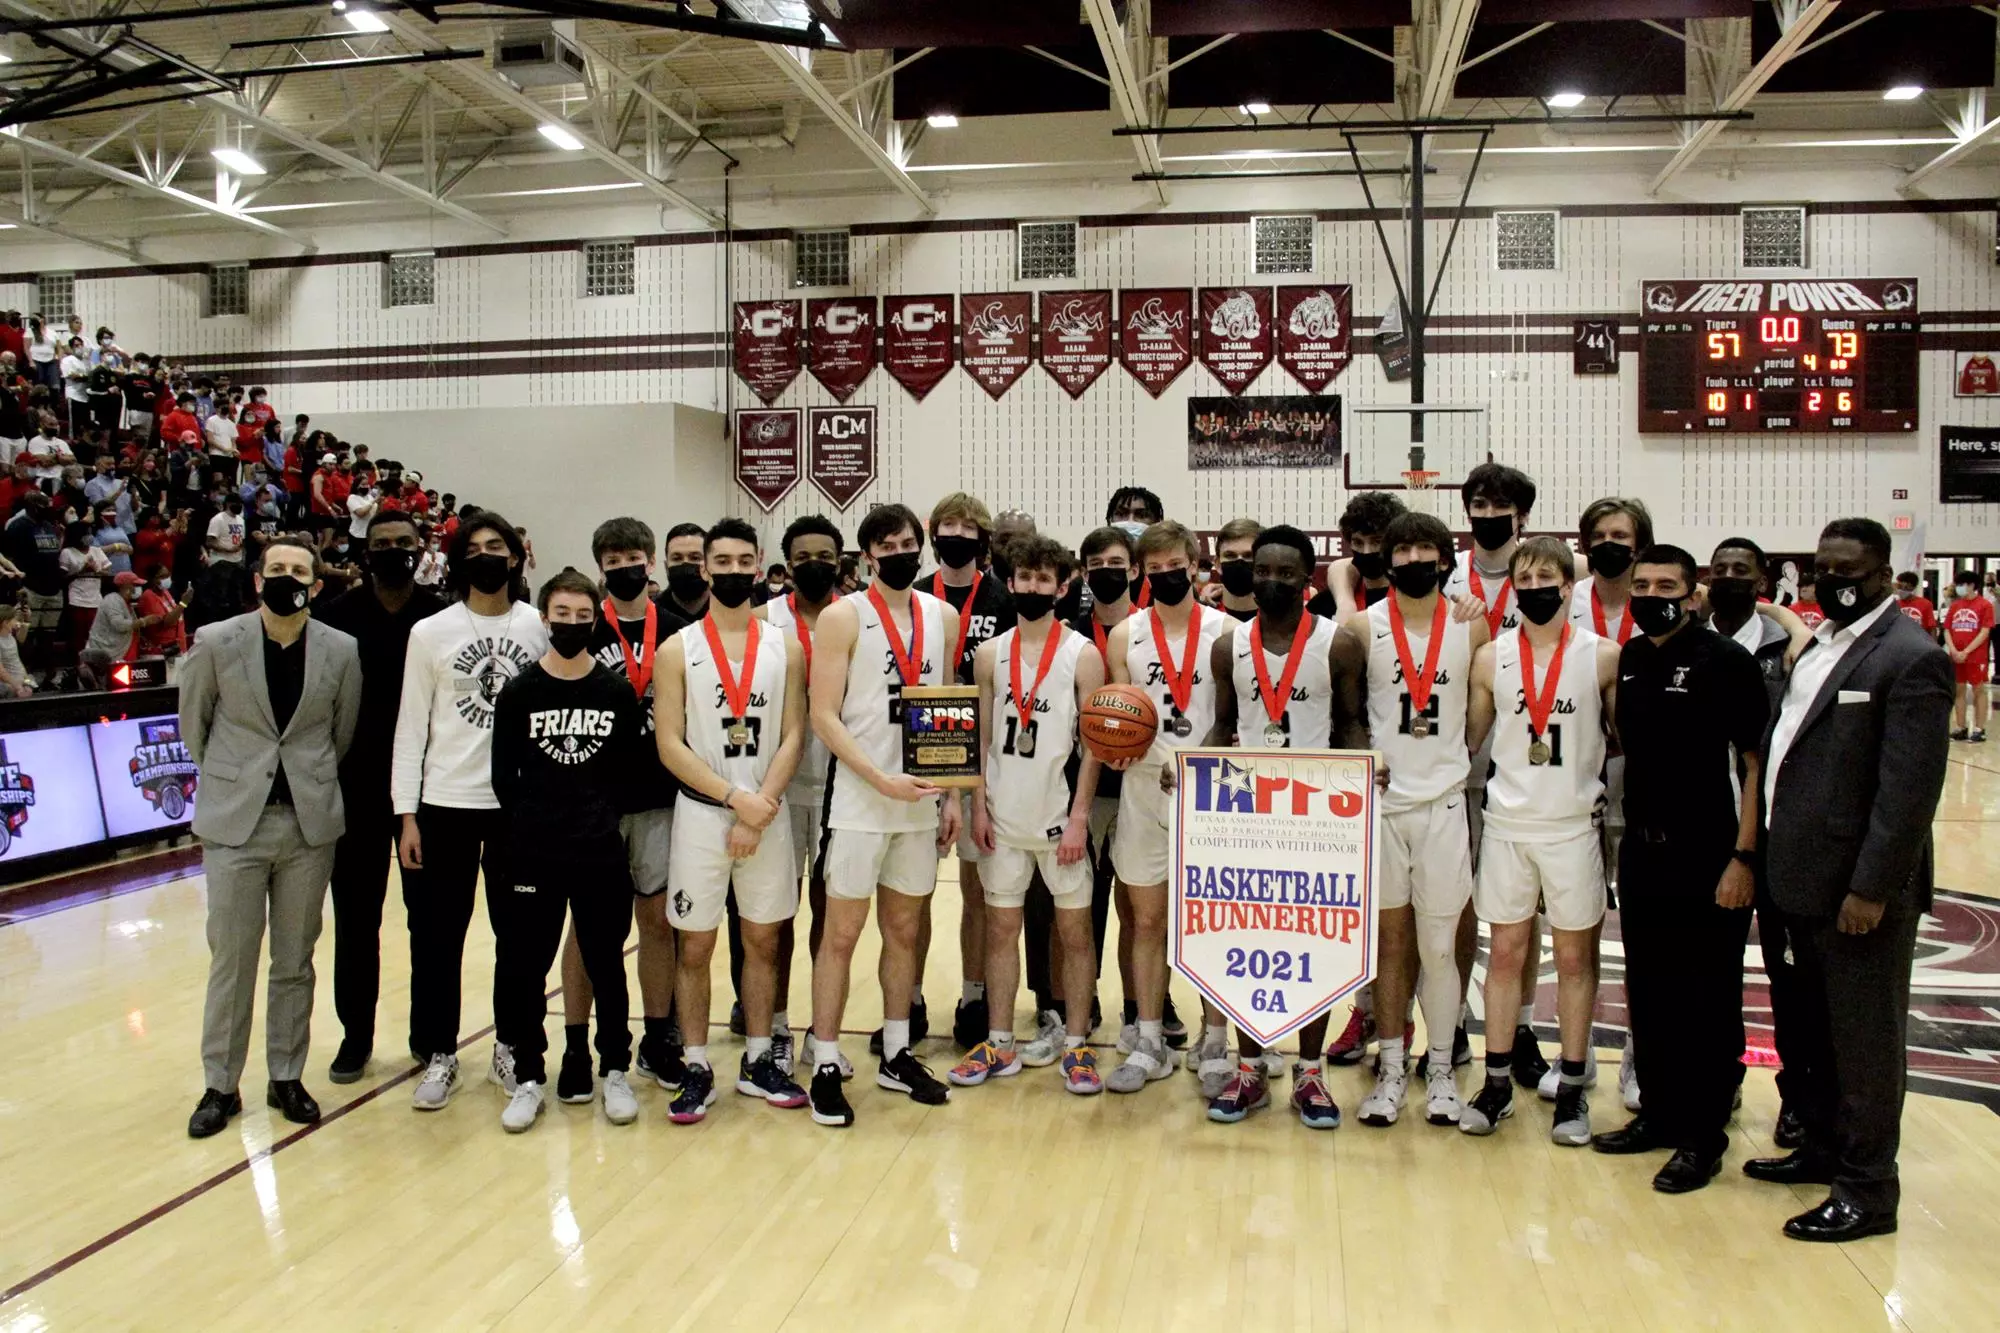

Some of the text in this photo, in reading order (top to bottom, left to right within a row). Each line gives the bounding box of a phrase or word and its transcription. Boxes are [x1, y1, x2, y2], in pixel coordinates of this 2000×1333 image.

[1675, 282, 1884, 312] TIGER POWER
[1706, 320, 1736, 332] Tigers
[1762, 318, 1798, 342] 0.0
[1586, 334, 1604, 348] 44
[1708, 333, 1740, 358] 57
[1827, 333, 1857, 358] 73
[1002, 356, 1027, 364] CHAMPS
[1764, 354, 1816, 371] period 4
[1706, 377, 1728, 387] fouls
[1764, 376, 1794, 388] player
[1831, 377, 1853, 387] fouls
[1708, 392, 1726, 411] 10
[1745, 394, 1751, 410] 1
[1808, 392, 1821, 411] 2
[1838, 392, 1851, 411] 6
[818, 415, 867, 439] ACM
[1767, 418, 1790, 428] game
[1832, 418, 1851, 426] won
[1948, 439, 1986, 452] Here,
[453, 637, 494, 675] BISHOP
[131, 668, 150, 680] POSS.
[456, 696, 494, 728] BASKE
[1092, 696, 1142, 716] Wilson
[1399, 693, 1439, 735] 12
[530, 708, 615, 738] FRIARS
[908, 707, 975, 731] TAPPS
[1186, 757, 1364, 818] TAPPS
[1195, 815, 1226, 824] TEXAS
[1230, 816, 1297, 826] ASSOCIATION
[1316, 820, 1359, 830] PRIVATE
[1232, 827, 1293, 837] PAROCHIAL
[1298, 830, 1347, 839] SCHOOLS
[1190, 836, 1358, 854] COMPETITION WITH HONOR
[1185, 865, 1361, 907] BASKETBALL
[1184, 899, 1360, 944] RUNNERUP
[1226, 948, 1312, 983] 2021
[1251, 989, 1288, 1013] 6A
